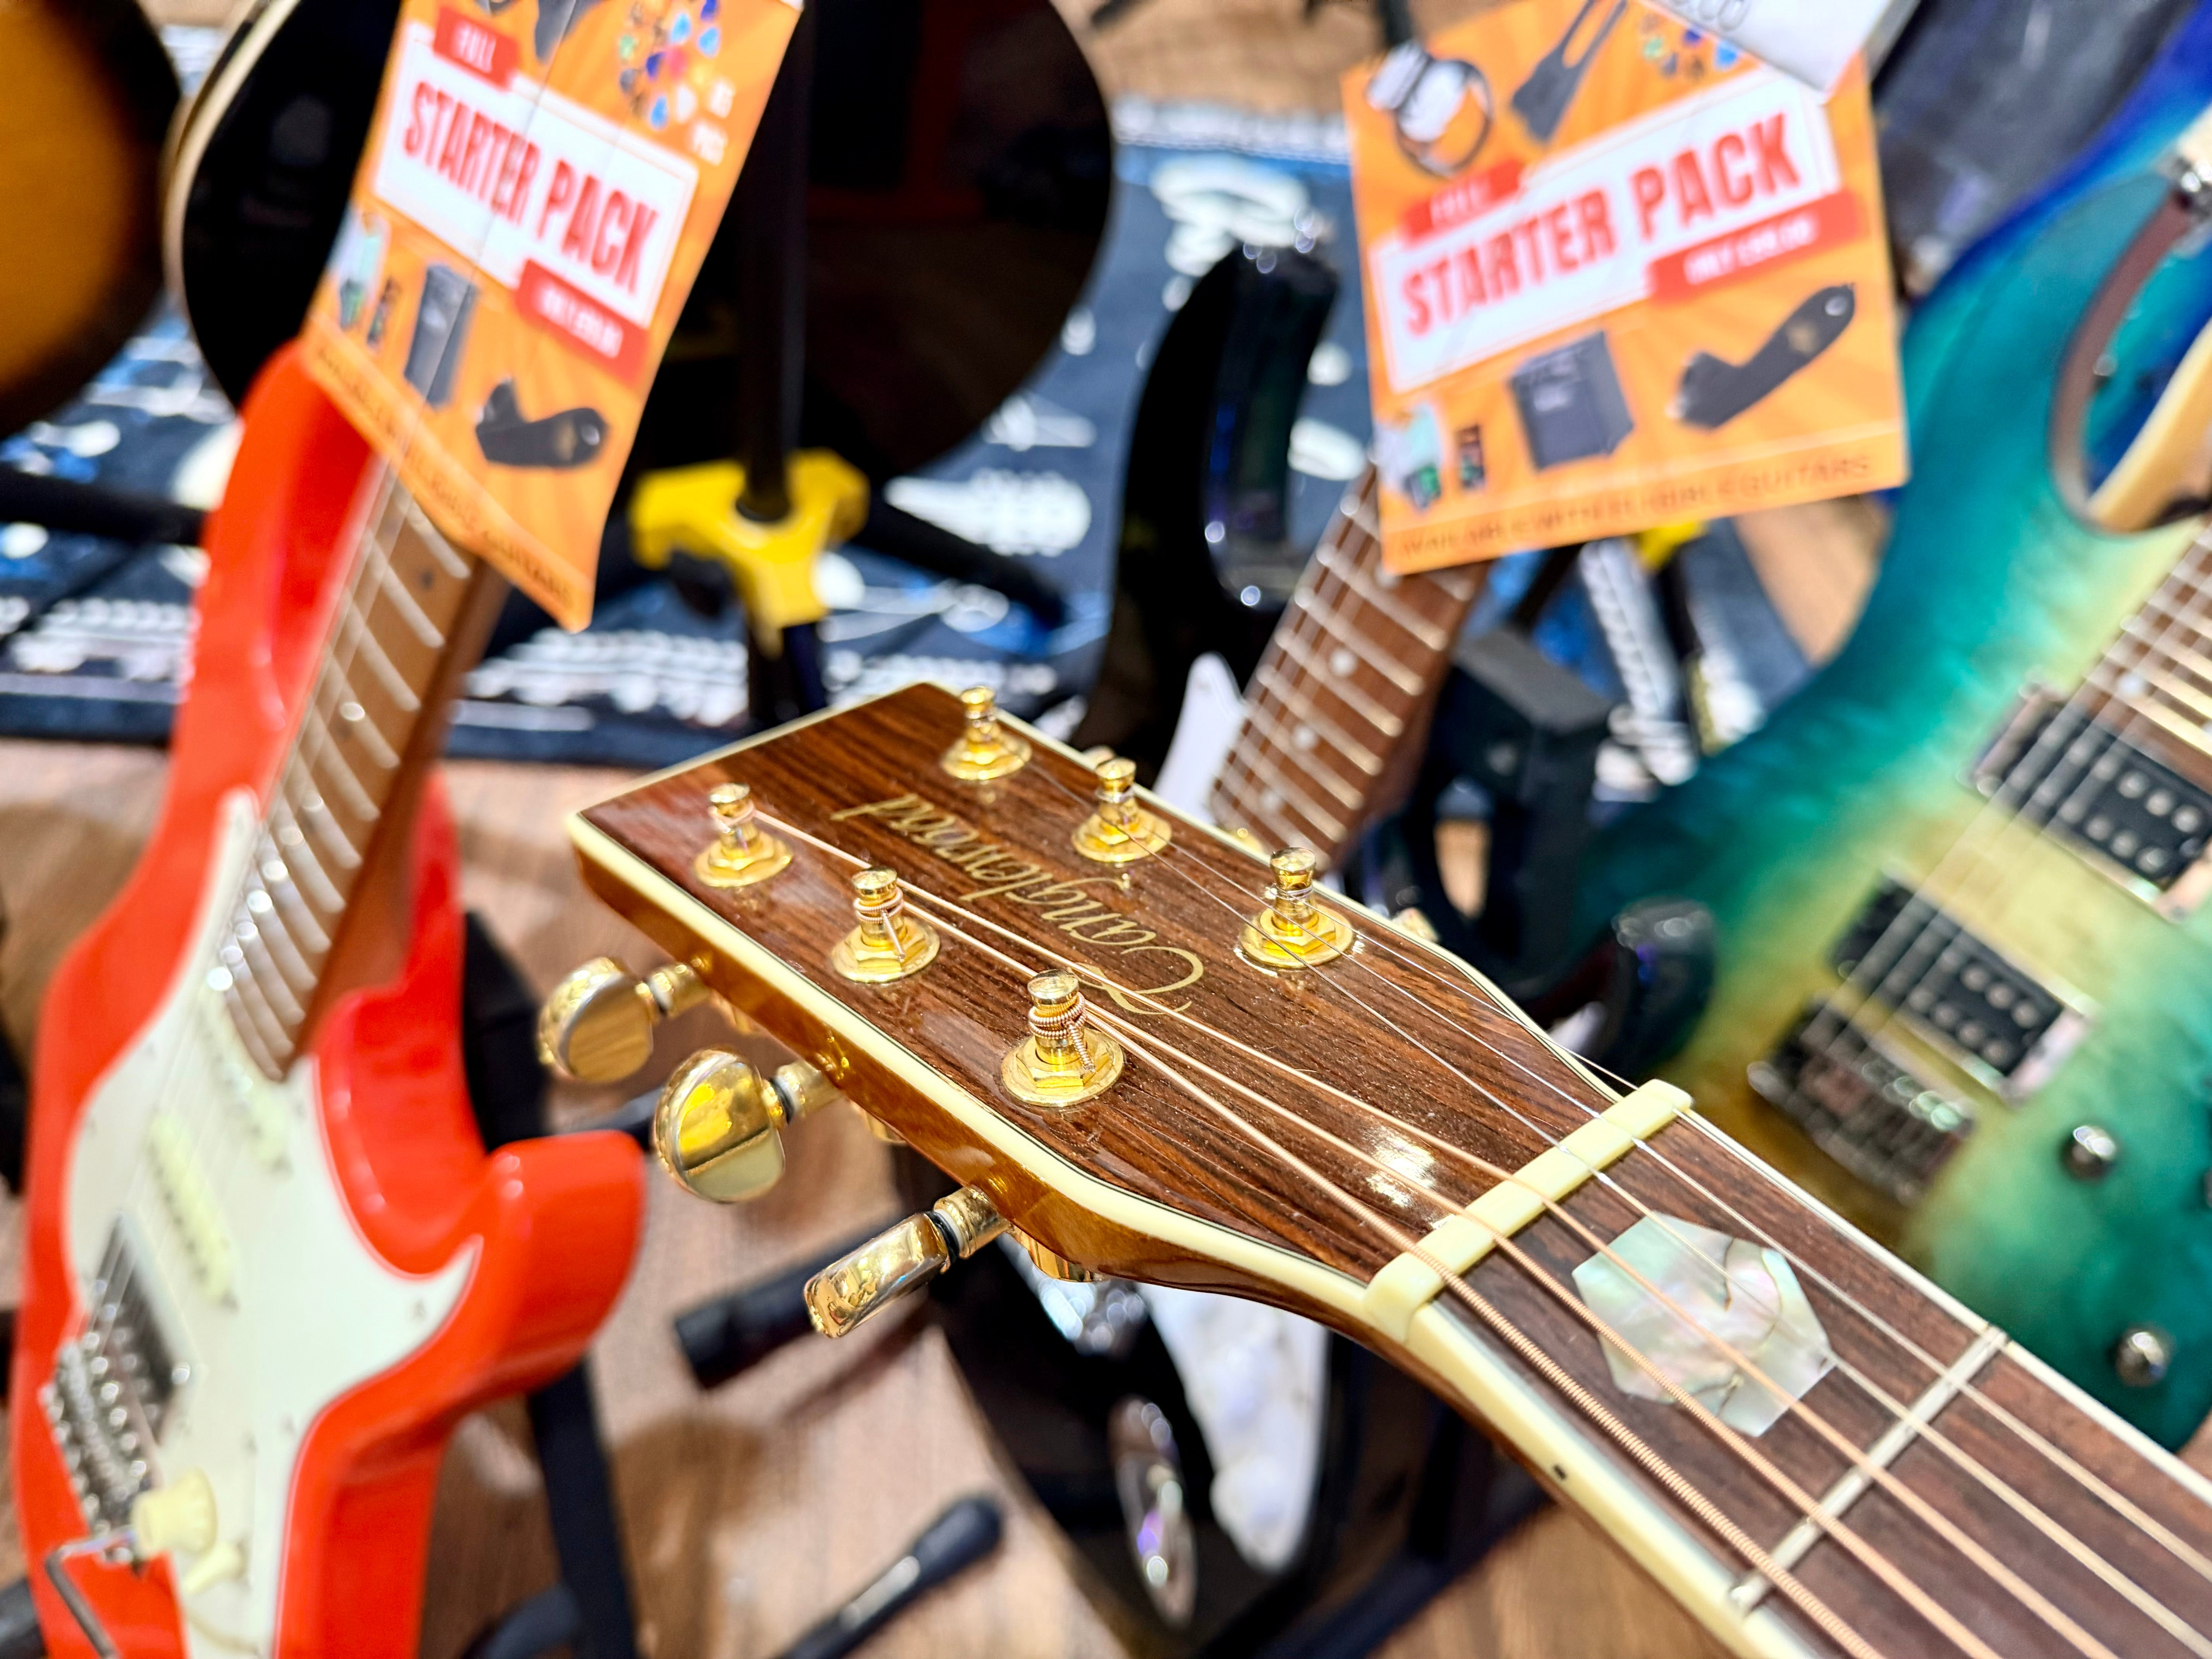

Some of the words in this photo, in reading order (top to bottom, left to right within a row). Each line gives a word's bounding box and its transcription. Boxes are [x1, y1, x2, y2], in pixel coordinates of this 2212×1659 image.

[404, 80, 541, 228] STARTER
[535, 158, 659, 296] PACK
[1400, 189, 1617, 337] STARTER
[1628, 111, 1802, 240] PACK
[830, 793, 1203, 1015] Tanglewood
